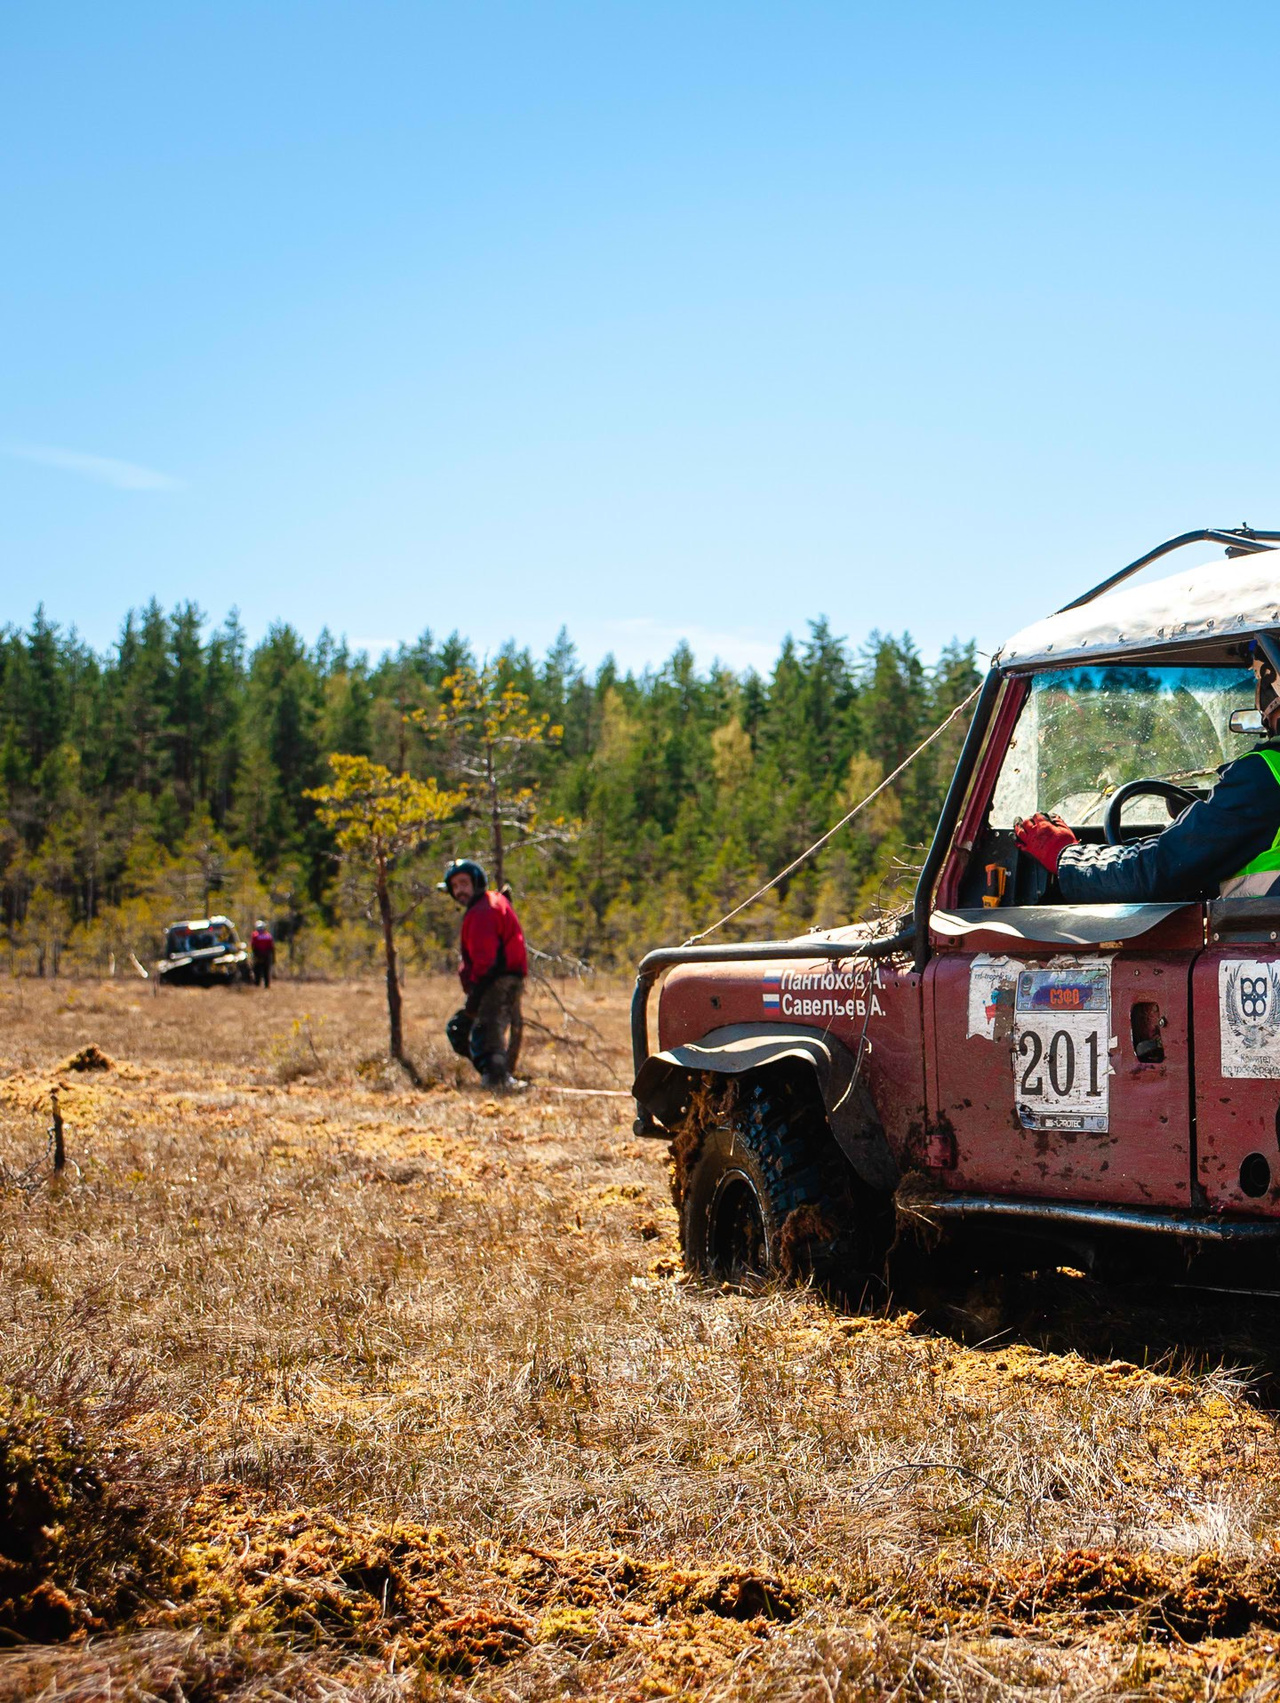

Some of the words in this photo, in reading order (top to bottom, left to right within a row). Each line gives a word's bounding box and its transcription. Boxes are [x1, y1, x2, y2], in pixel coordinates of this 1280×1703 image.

[781, 969, 865, 990] Пантюхов
[782, 993, 866, 1016] Савельев
[1050, 988, 1079, 1005] СЗФО
[1019, 1030, 1102, 1096] 201
